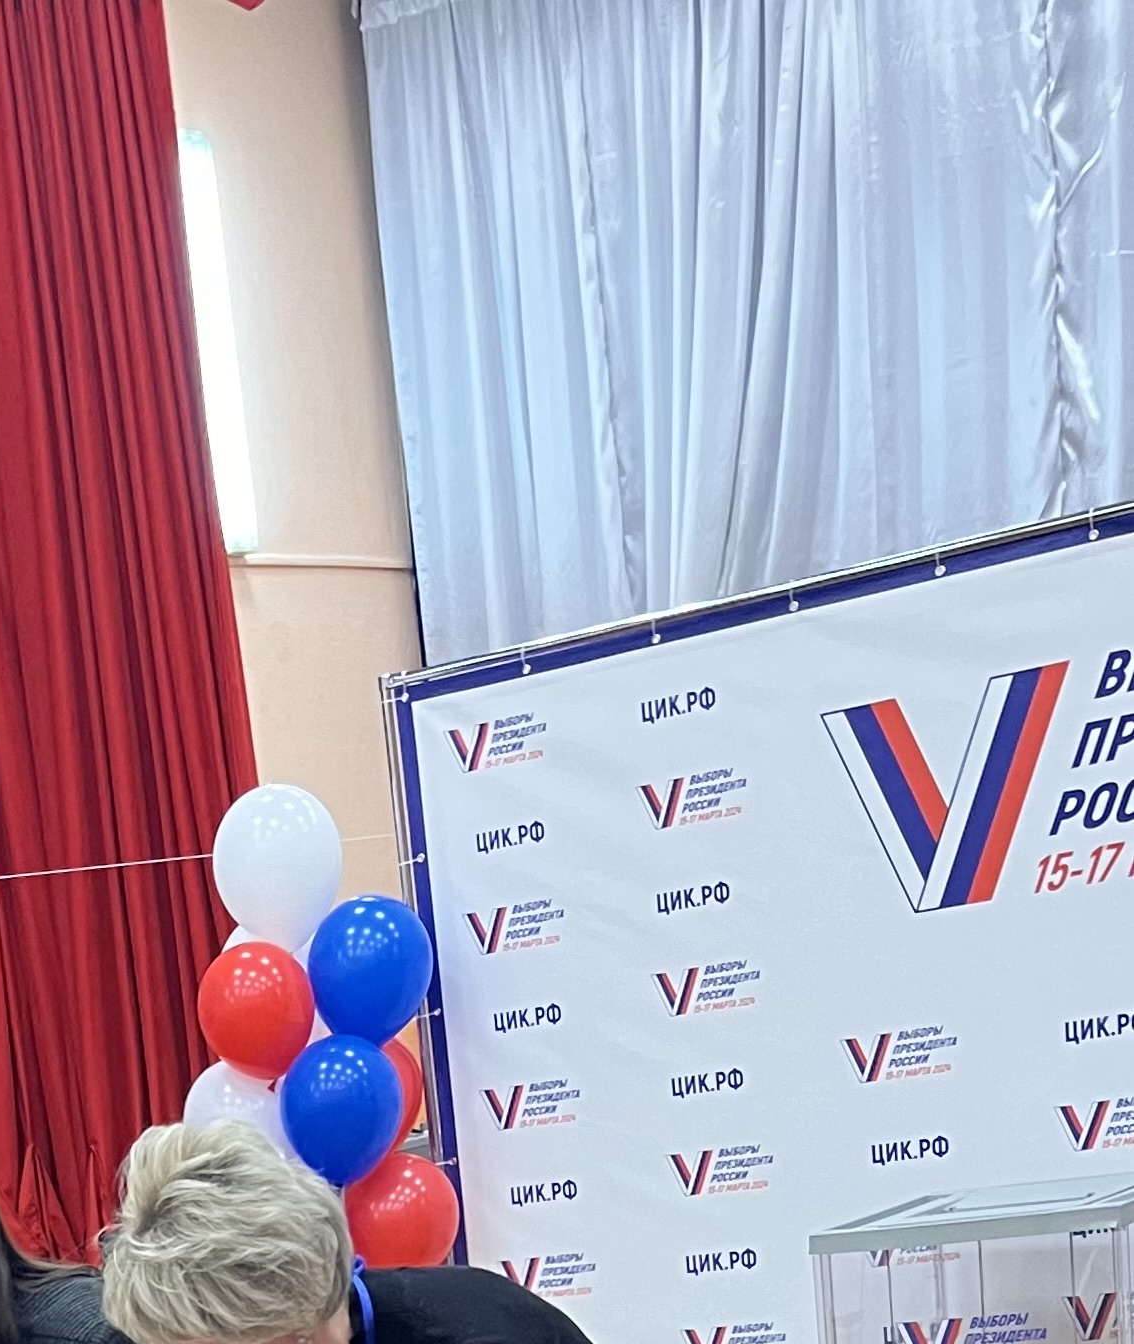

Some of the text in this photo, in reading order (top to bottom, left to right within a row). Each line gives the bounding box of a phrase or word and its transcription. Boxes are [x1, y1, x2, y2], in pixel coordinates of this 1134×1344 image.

[641, 686, 716, 725] ЦИК.РФ
[689, 767, 732, 785] ВЫБОРЫ
[686, 778, 746, 799] ПРЕЗИДЕНТА
[682, 796, 721, 813] РОССИИ
[476, 820, 545, 854] ЦИК.РФ
[1034, 842, 1125, 894] 15-17
[511, 898, 551, 914] ВЫБОРЫ
[656, 881, 730, 915] ЦИК.РФ
[505, 926, 540, 940] РОССИИ
[704, 959, 747, 975] ВЫБОРЫ
[700, 970, 760, 988] ПРЕЗИДЕНТА
[696, 987, 735, 1001] РОССИИ
[494, 1003, 561, 1033] ЦИК.РФ
[897, 1025, 943, 1041] ВЫБОРЫ
[1065, 1014, 1134, 1044] ЦИК.Р
[893, 1037, 957, 1054] ПРЕЗИДЕНТА
[888, 1054, 930, 1068] РОССИИ
[528, 1078, 567, 1092] ВЫБОРЫ
[671, 1068, 743, 1098] ЦИК.РФ
[522, 1104, 557, 1117] РОССИИ
[718, 1144, 760, 1157] ВЫБОРЫ
[871, 1135, 949, 1165] ЦИК.РФ
[714, 1155, 773, 1170] ПРЕЗИДЕНТА
[710, 1170, 748, 1182] РОССИИ
[510, 1179, 577, 1206] ЦИК.РФ
[545, 1252, 584, 1265] ВЫБОРЫ
[686, 1248, 757, 1275] ЦИК.РФ
[541, 1263, 596, 1276] ПРЕЗИДЕНТА
[538, 1278, 573, 1288] РОССИИ
[731, 1322, 773, 1333] ВЫБОРЫ
[969, 1312, 1029, 1329] ВЫБОРЫ
